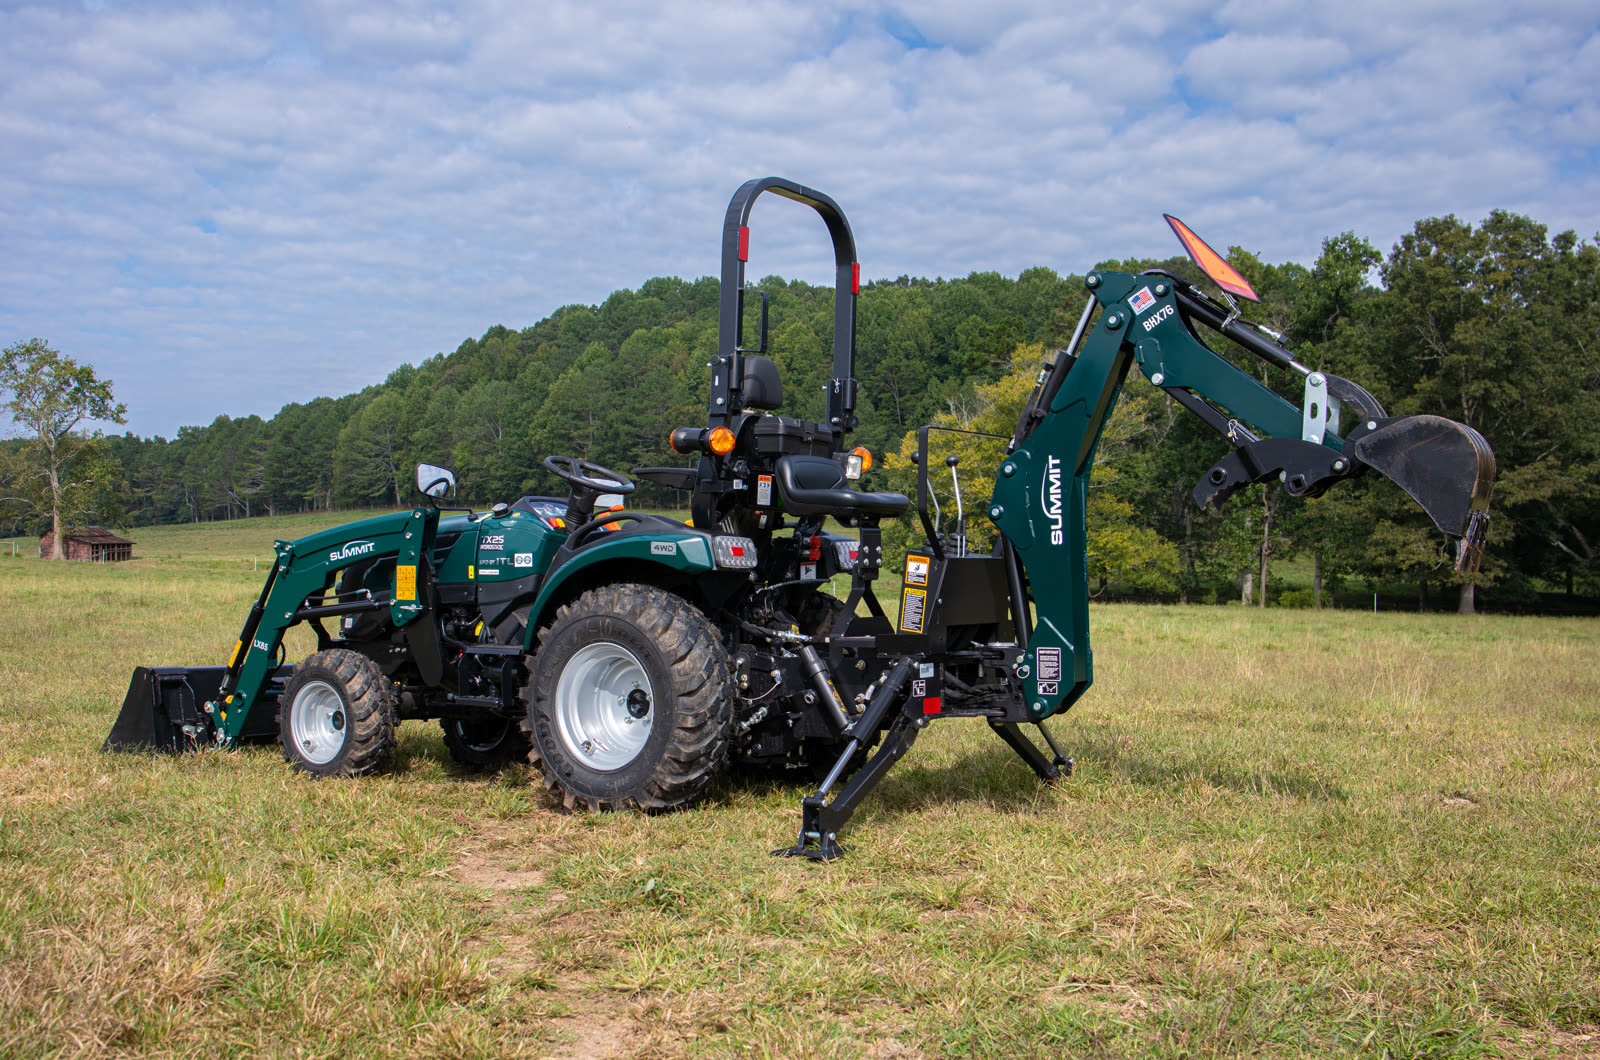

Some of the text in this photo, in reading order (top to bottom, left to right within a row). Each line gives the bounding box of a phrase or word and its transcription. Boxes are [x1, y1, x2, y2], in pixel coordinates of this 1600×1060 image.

[1142, 304, 1174, 332] BHX76
[1041, 455, 1063, 545] SUMMIT
[481, 535, 504, 544] TX25
[653, 544, 674, 552] 4WD
[329, 540, 376, 561] SUMMIT
[253, 639, 269, 652] LX85
